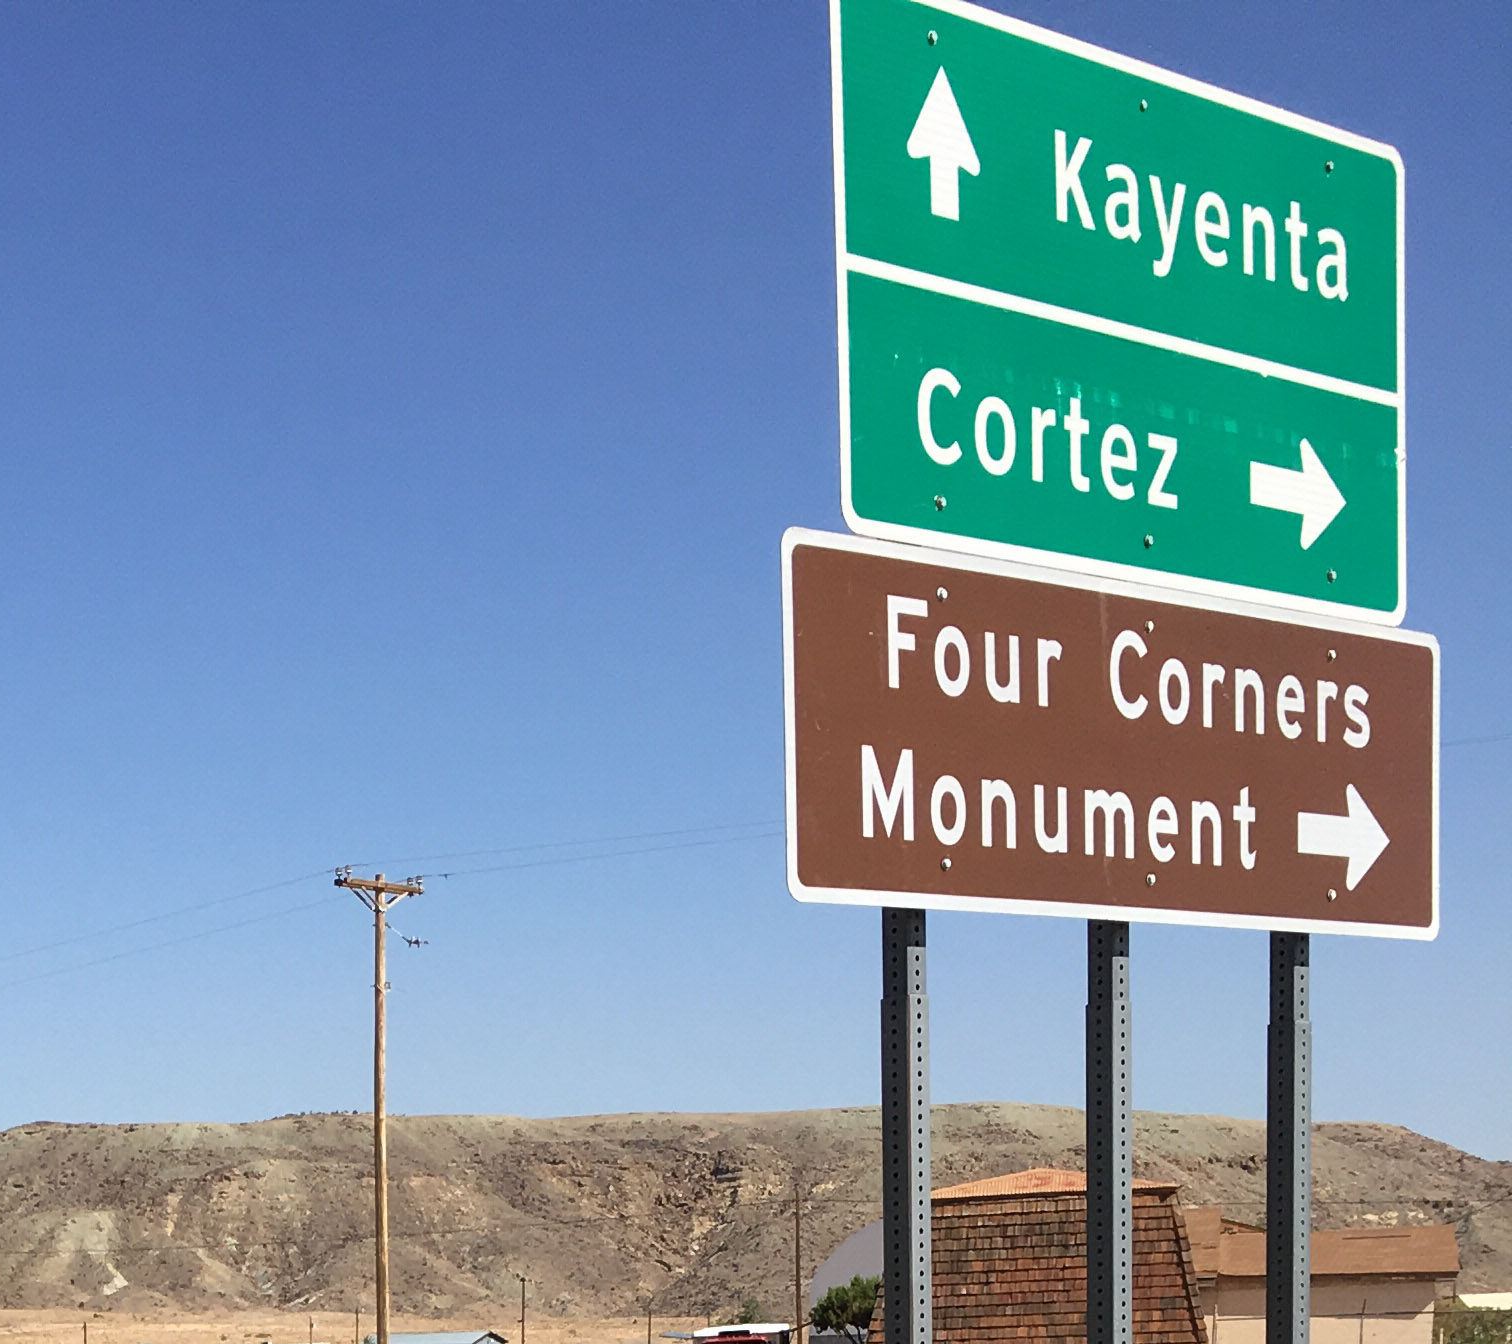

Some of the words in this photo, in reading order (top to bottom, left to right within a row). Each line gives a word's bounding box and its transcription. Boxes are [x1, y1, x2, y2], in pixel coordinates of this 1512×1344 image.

[1053, 129, 1350, 304] Kayenta
[916, 367, 1179, 510] Cortez
[885, 594, 1064, 708] Four
[1108, 629, 1373, 750] Corners
[860, 744, 1258, 871] Monument
